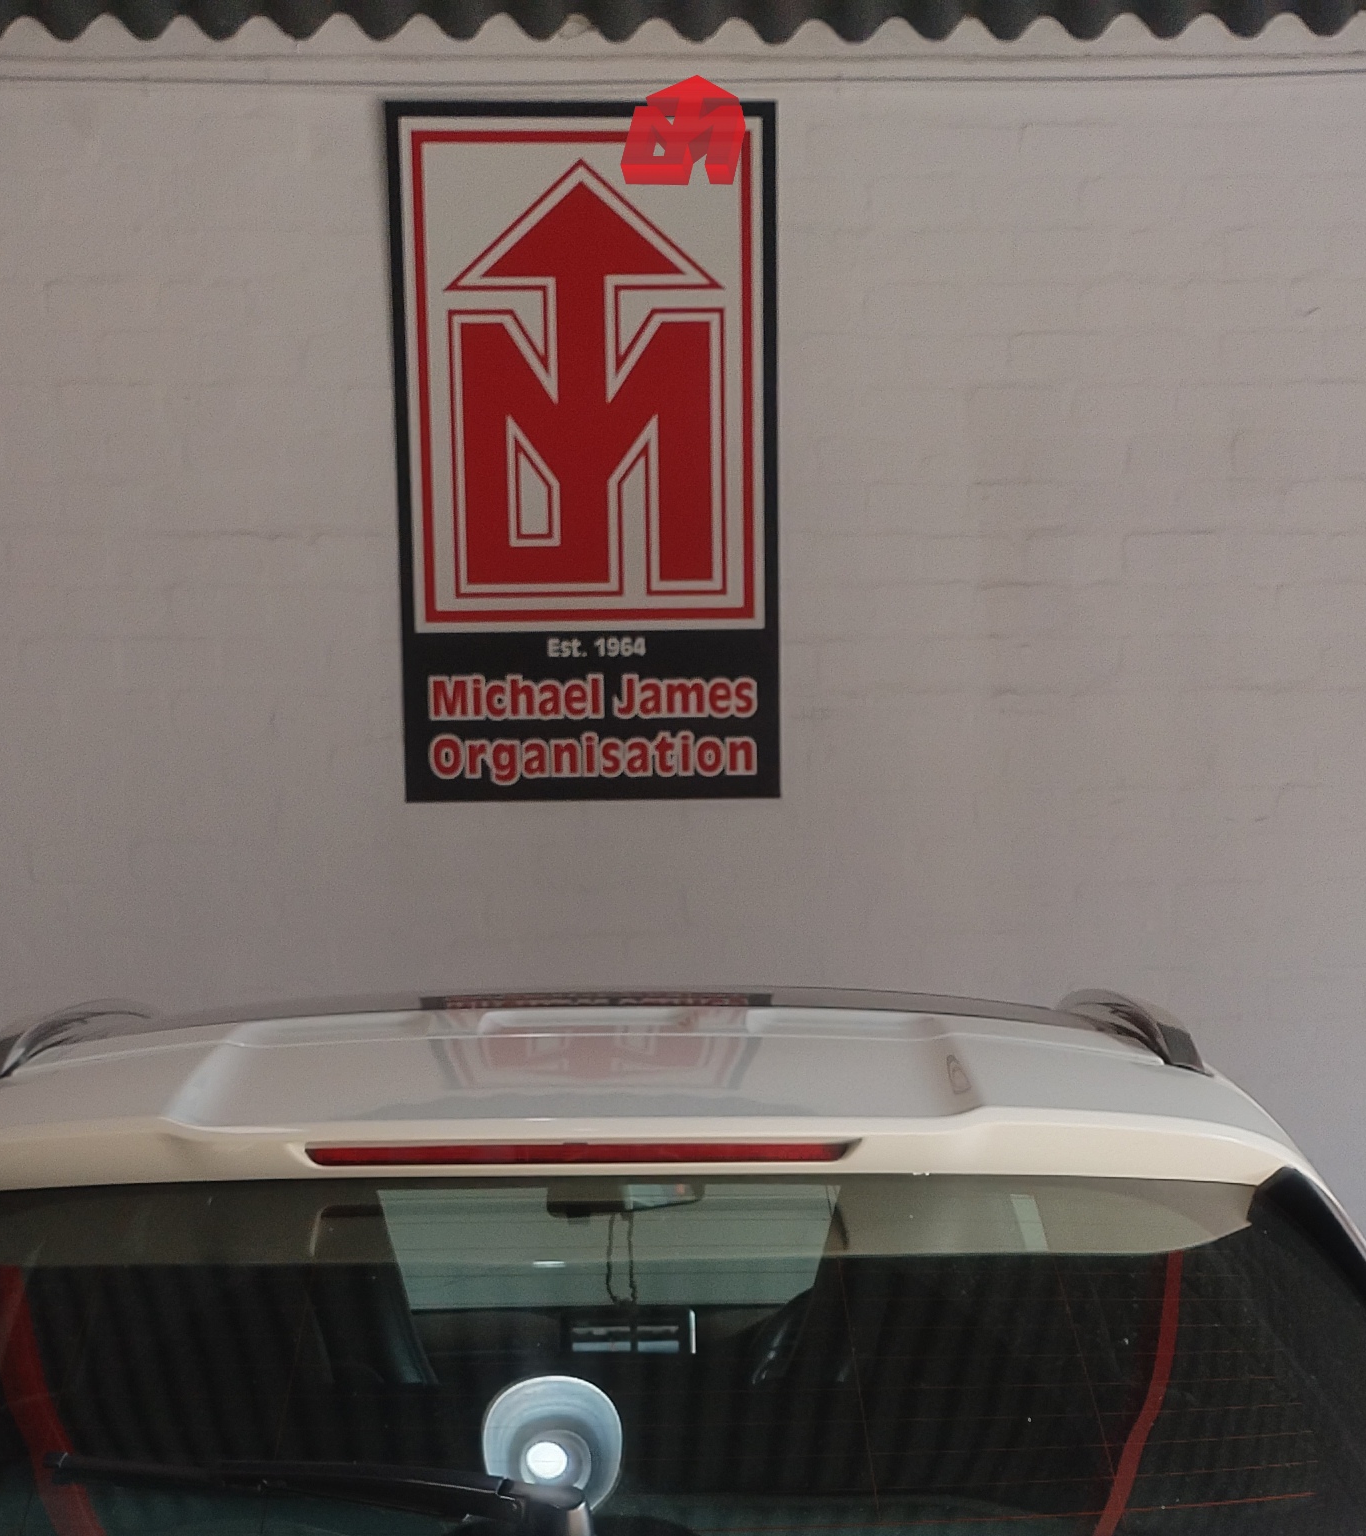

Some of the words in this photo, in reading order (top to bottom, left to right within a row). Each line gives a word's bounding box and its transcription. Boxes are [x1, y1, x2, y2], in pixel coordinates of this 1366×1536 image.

[547, 637, 587, 658] Est.
[594, 636, 647, 657] 1964
[428, 673, 604, 721] Michael
[615, 671, 758, 719] James
[429, 731, 758, 786] Organisation
